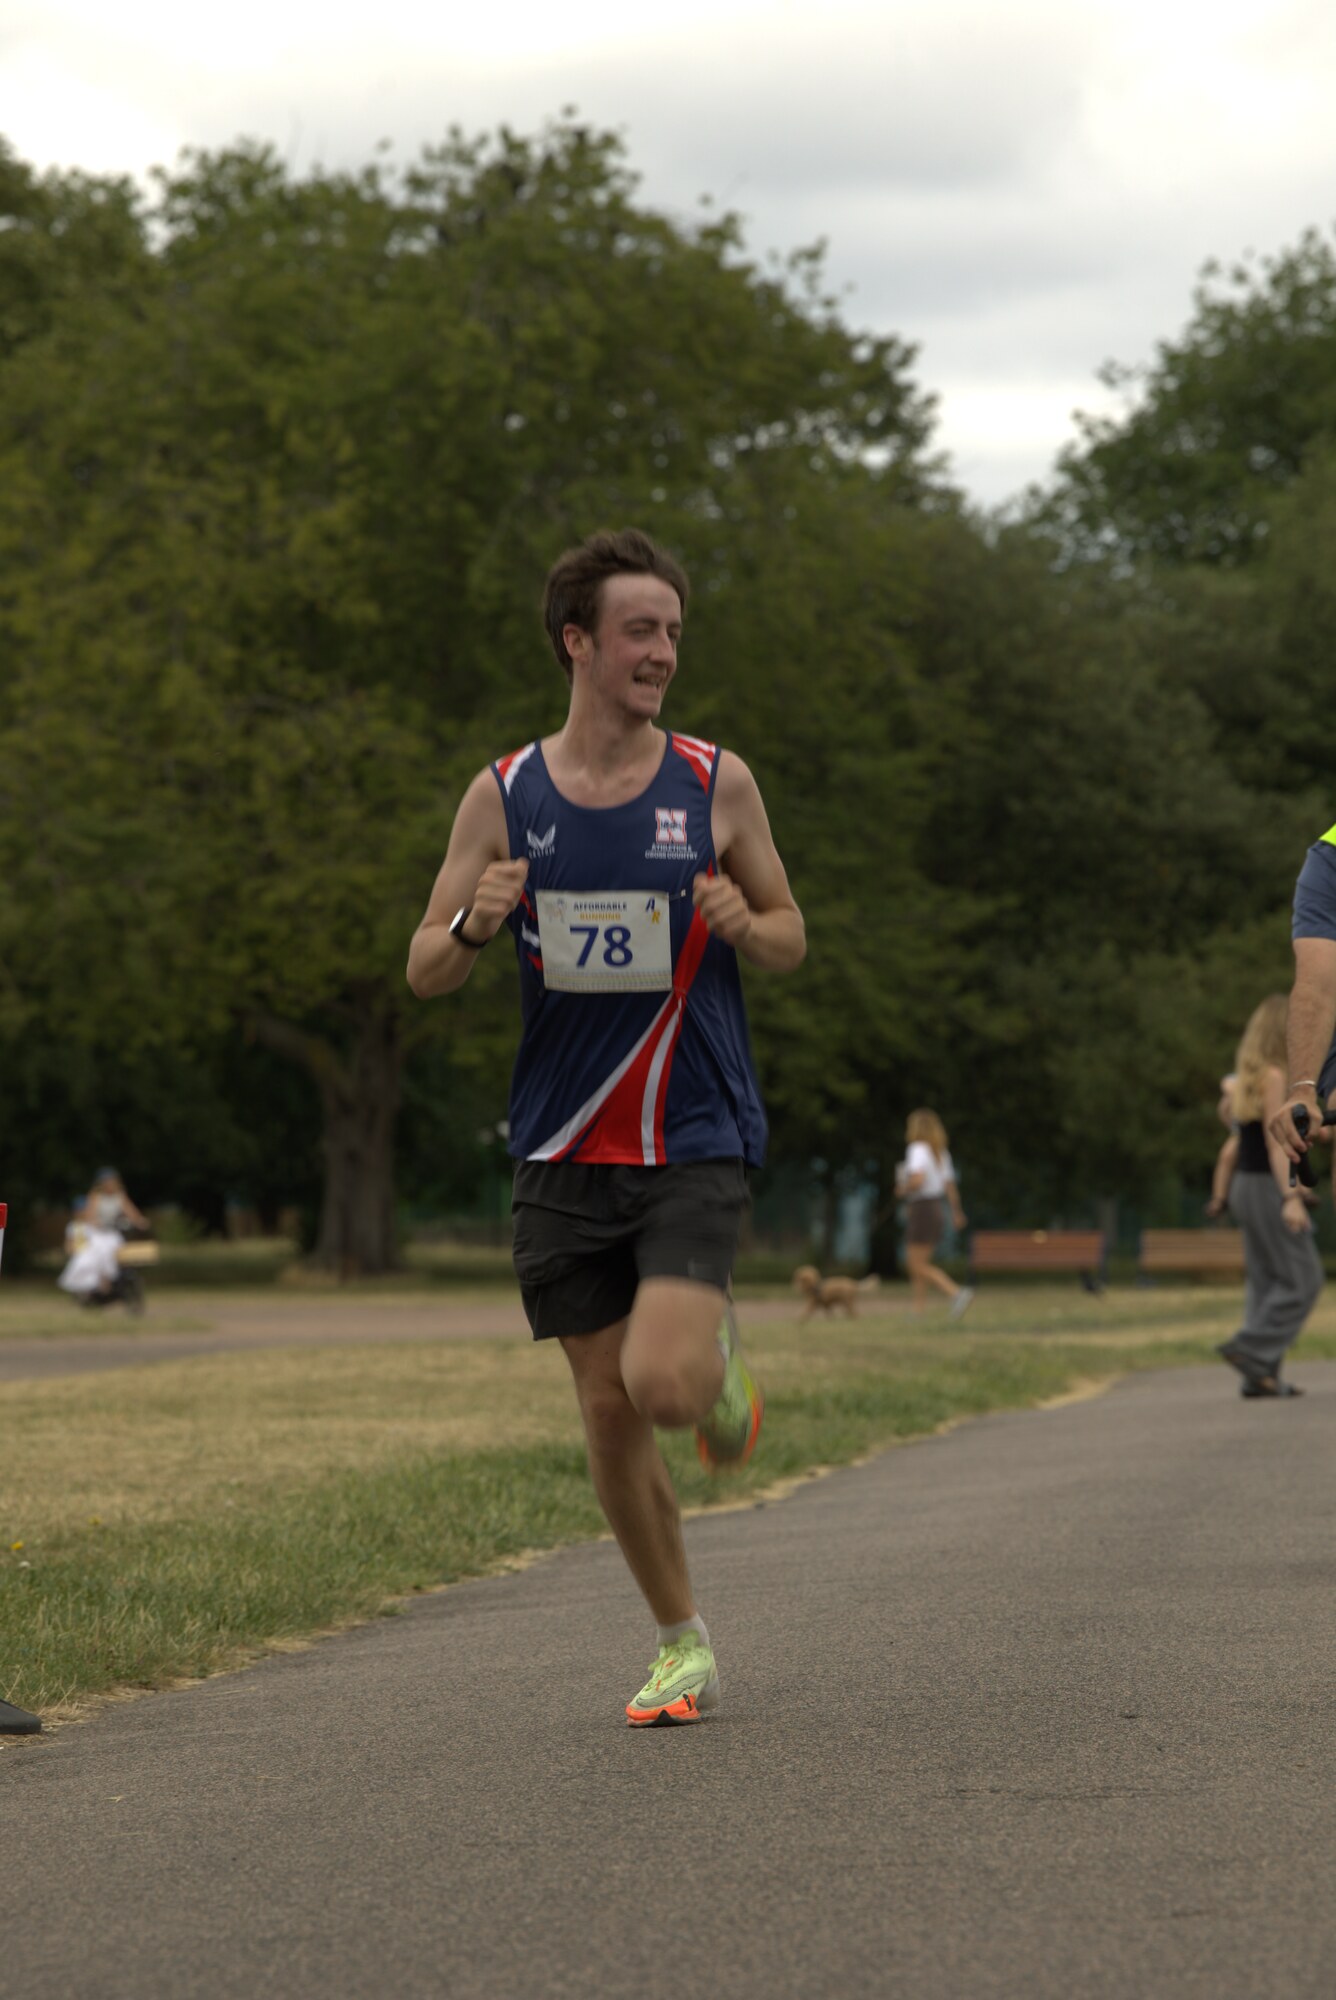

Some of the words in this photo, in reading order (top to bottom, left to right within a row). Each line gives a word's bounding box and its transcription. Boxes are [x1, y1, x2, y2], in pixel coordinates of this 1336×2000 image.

[573, 901, 627, 911] AFFORDABLE
[579, 913, 622, 921] RUNNING
[569, 925, 633, 968] 78
